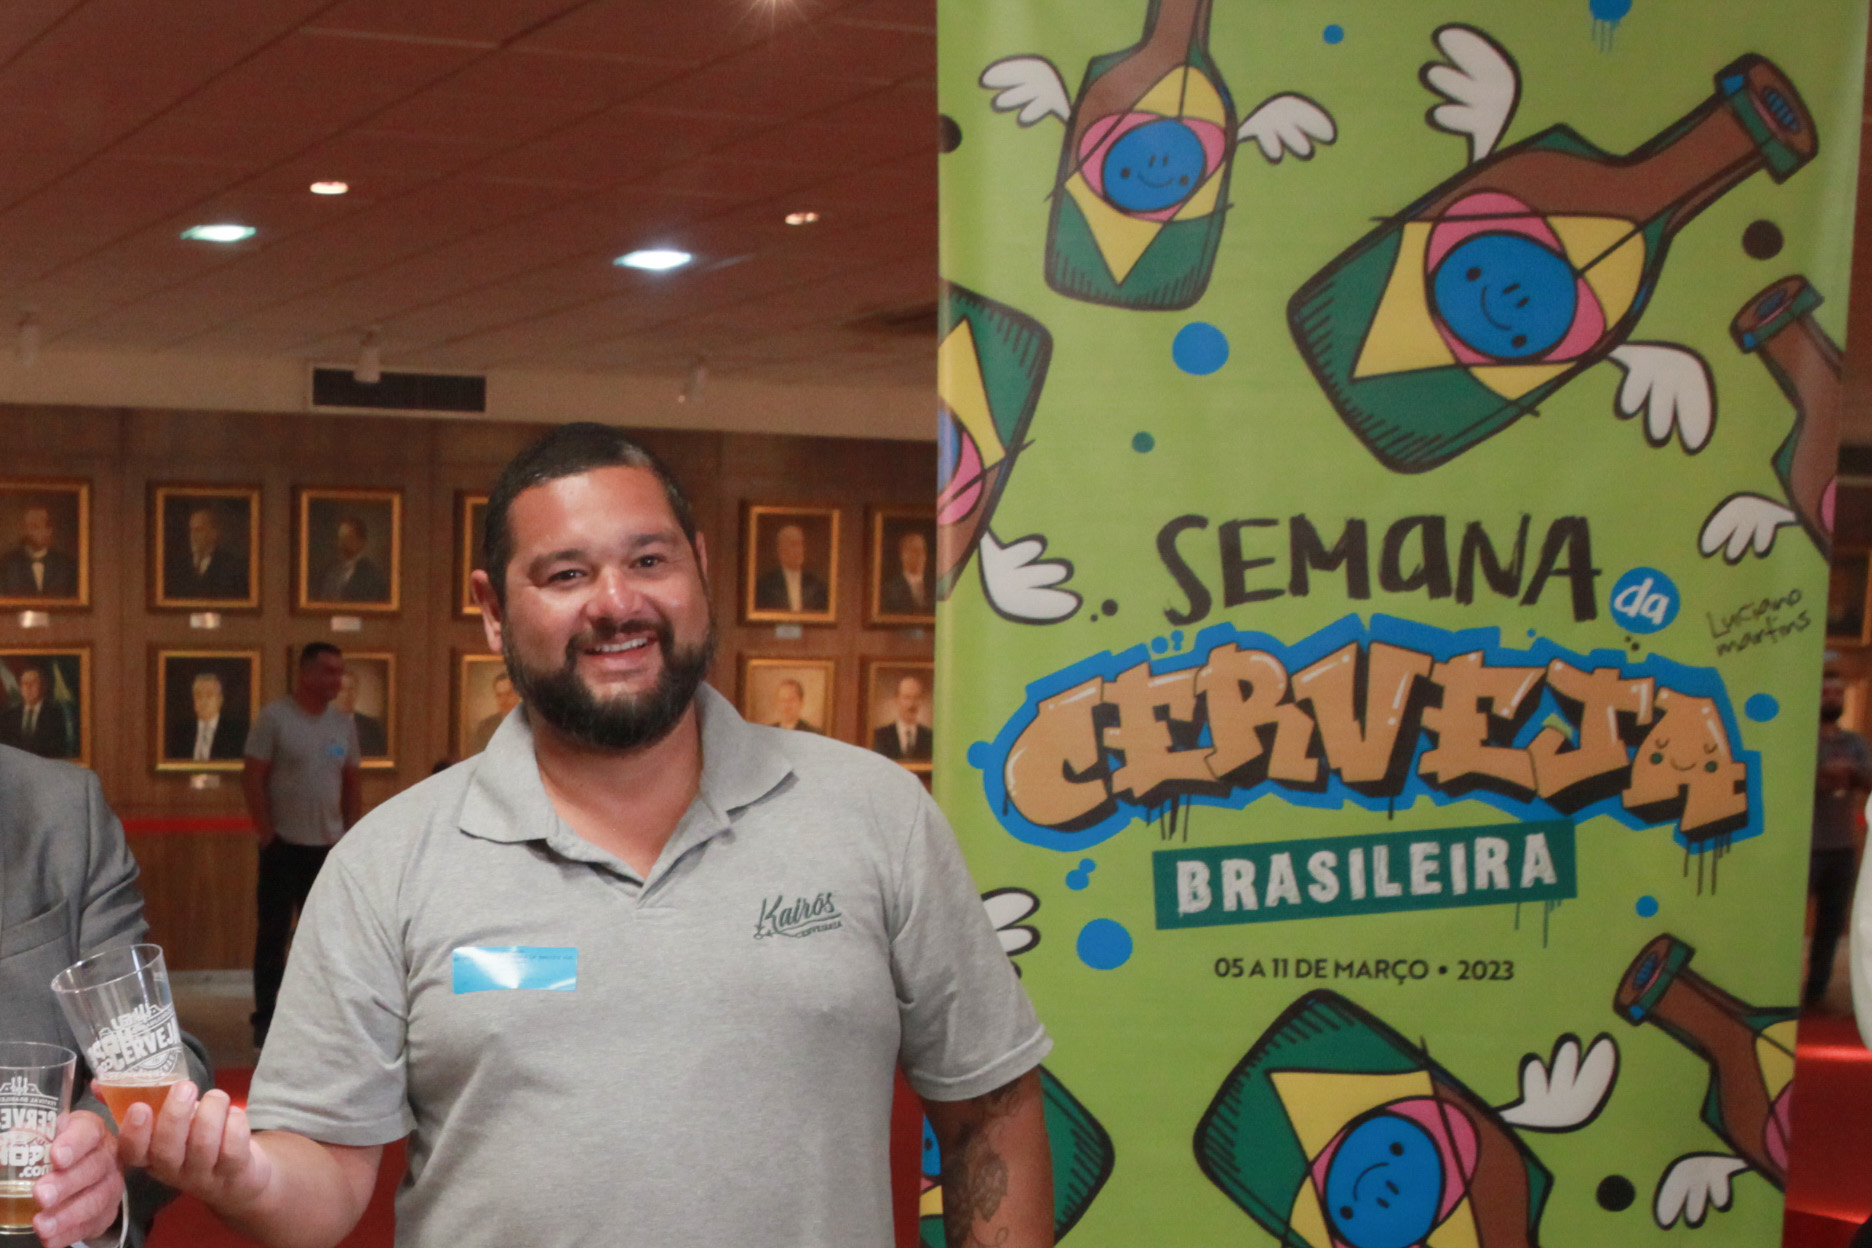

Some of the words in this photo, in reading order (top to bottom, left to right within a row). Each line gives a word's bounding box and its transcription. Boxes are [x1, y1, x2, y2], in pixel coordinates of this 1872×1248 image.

[1154, 513, 1603, 626] SEMANA
[1614, 577, 1670, 625] da
[1004, 640, 1750, 840] CERVEJA
[1176, 832, 1558, 916] BRASILEIRA
[1214, 957, 1244, 978] 05
[1249, 959, 1266, 978] A
[1272, 958, 1289, 978] 11
[1296, 958, 1328, 978] DE
[1334, 959, 1429, 985] MARÇO
[1457, 960, 1515, 980] 2023
